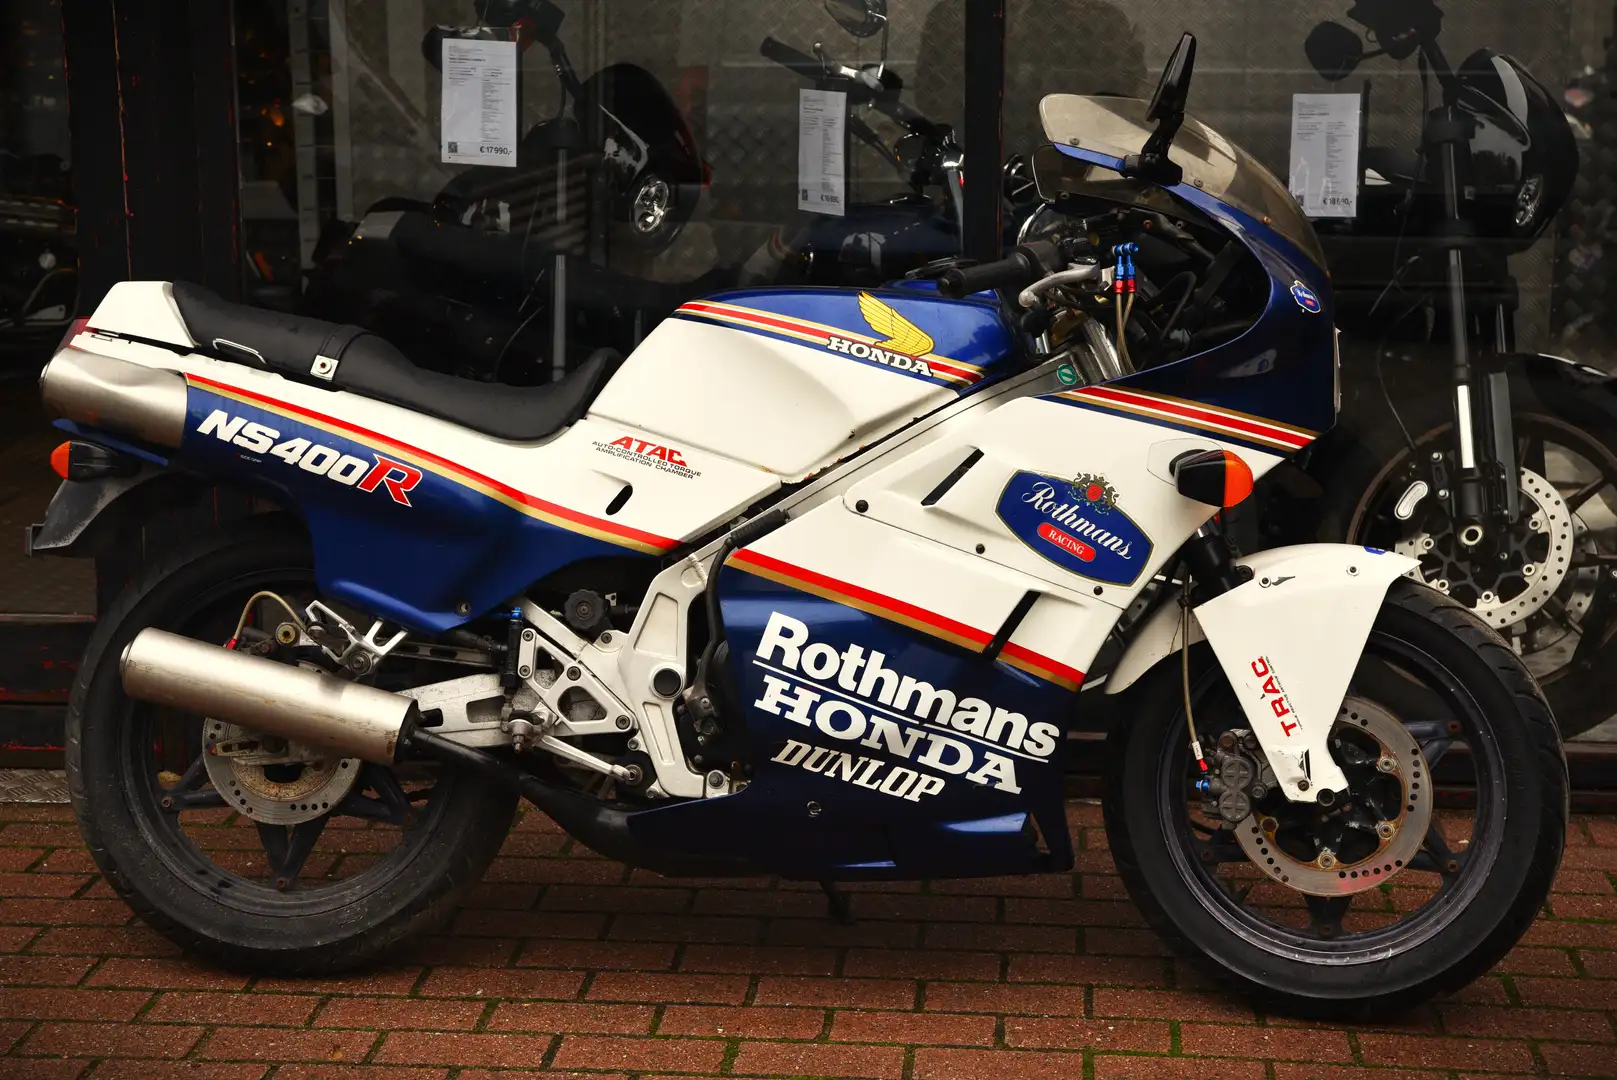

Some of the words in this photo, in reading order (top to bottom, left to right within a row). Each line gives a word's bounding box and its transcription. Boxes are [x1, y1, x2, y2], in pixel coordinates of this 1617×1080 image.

[826, 335, 934, 378] HONDA
[196, 408, 424, 508] NS400R
[595, 447, 653, 468] AMPLIFICATION
[655, 464, 694, 480] CHAMBER
[609, 435, 688, 468] ATAC
[669, 462, 702, 478] TORQUE
[1021, 481, 1132, 560] Rothmans
[1048, 529, 1085, 555] RACING
[755, 611, 1060, 757] Rothmans
[1251, 657, 1297, 738] TRAC
[753, 674, 1023, 795] HONDA
[770, 739, 946, 803] DUNLOP
